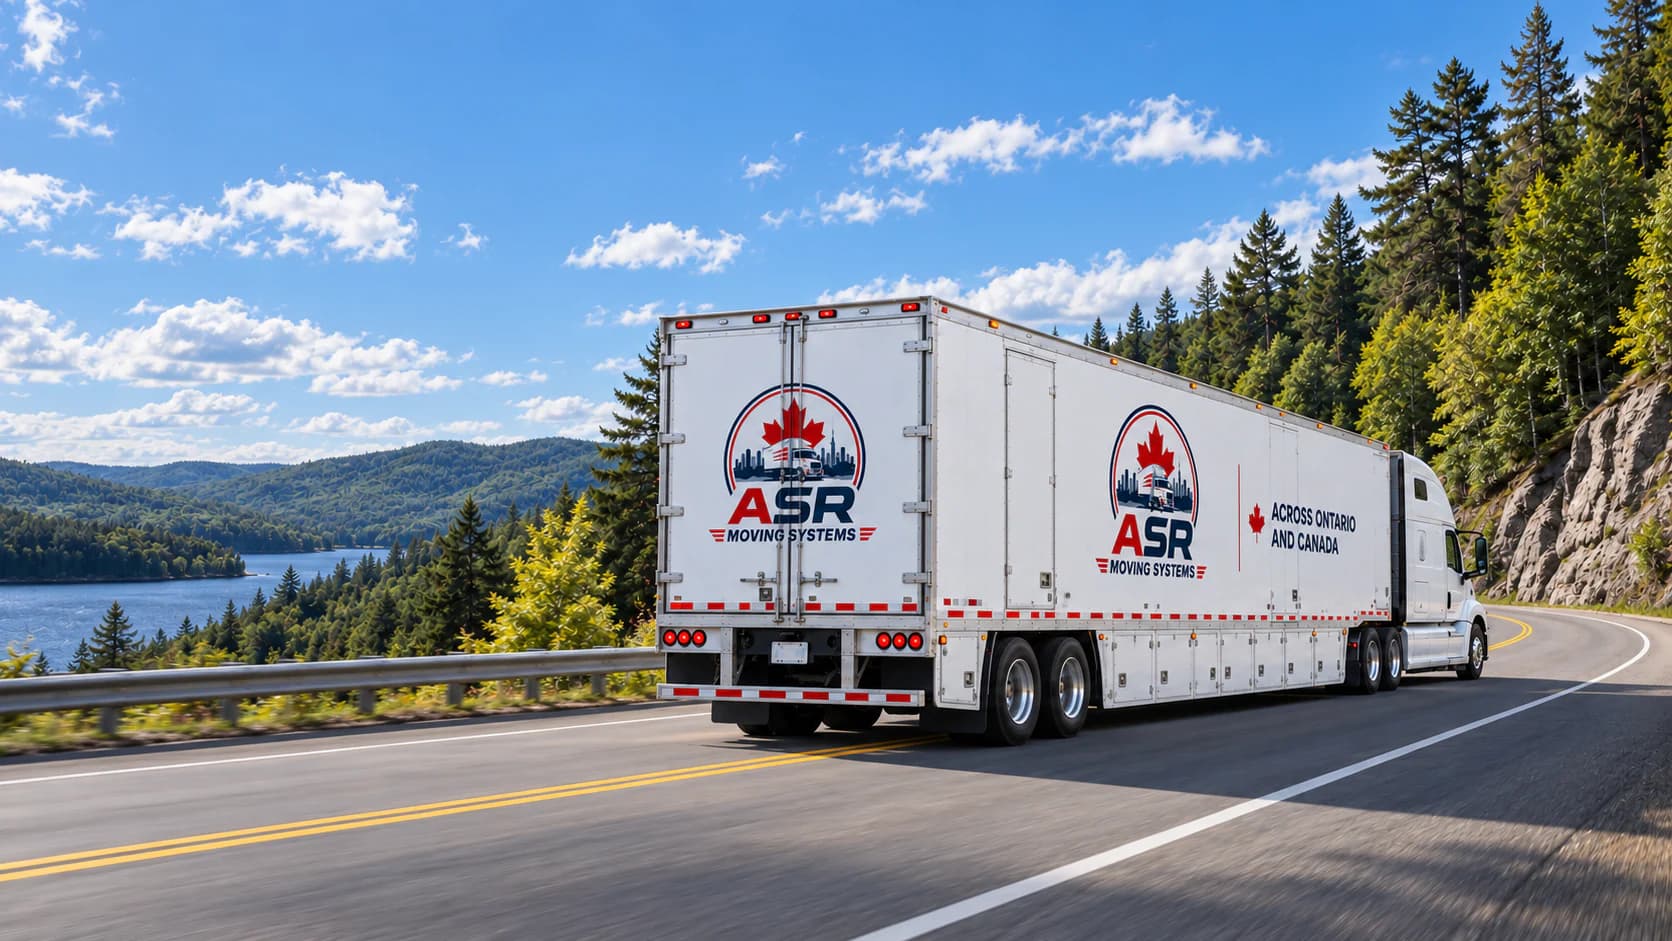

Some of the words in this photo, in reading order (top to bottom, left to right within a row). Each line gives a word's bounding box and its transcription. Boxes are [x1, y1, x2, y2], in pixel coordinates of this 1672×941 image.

[728, 486, 855, 524] ASR
[1271, 502, 1313, 526] ACROSS
[1315, 510, 1356, 533] ONTARIO
[727, 528, 785, 542] MOVING
[788, 528, 856, 542] SYSTEMS
[1112, 513, 1193, 560] ASR
[1271, 529, 1294, 549] AND
[1298, 532, 1339, 555] CANADA
[1110, 560, 1150, 577] MOVING
[1153, 562, 1195, 579] SYSTEMS
